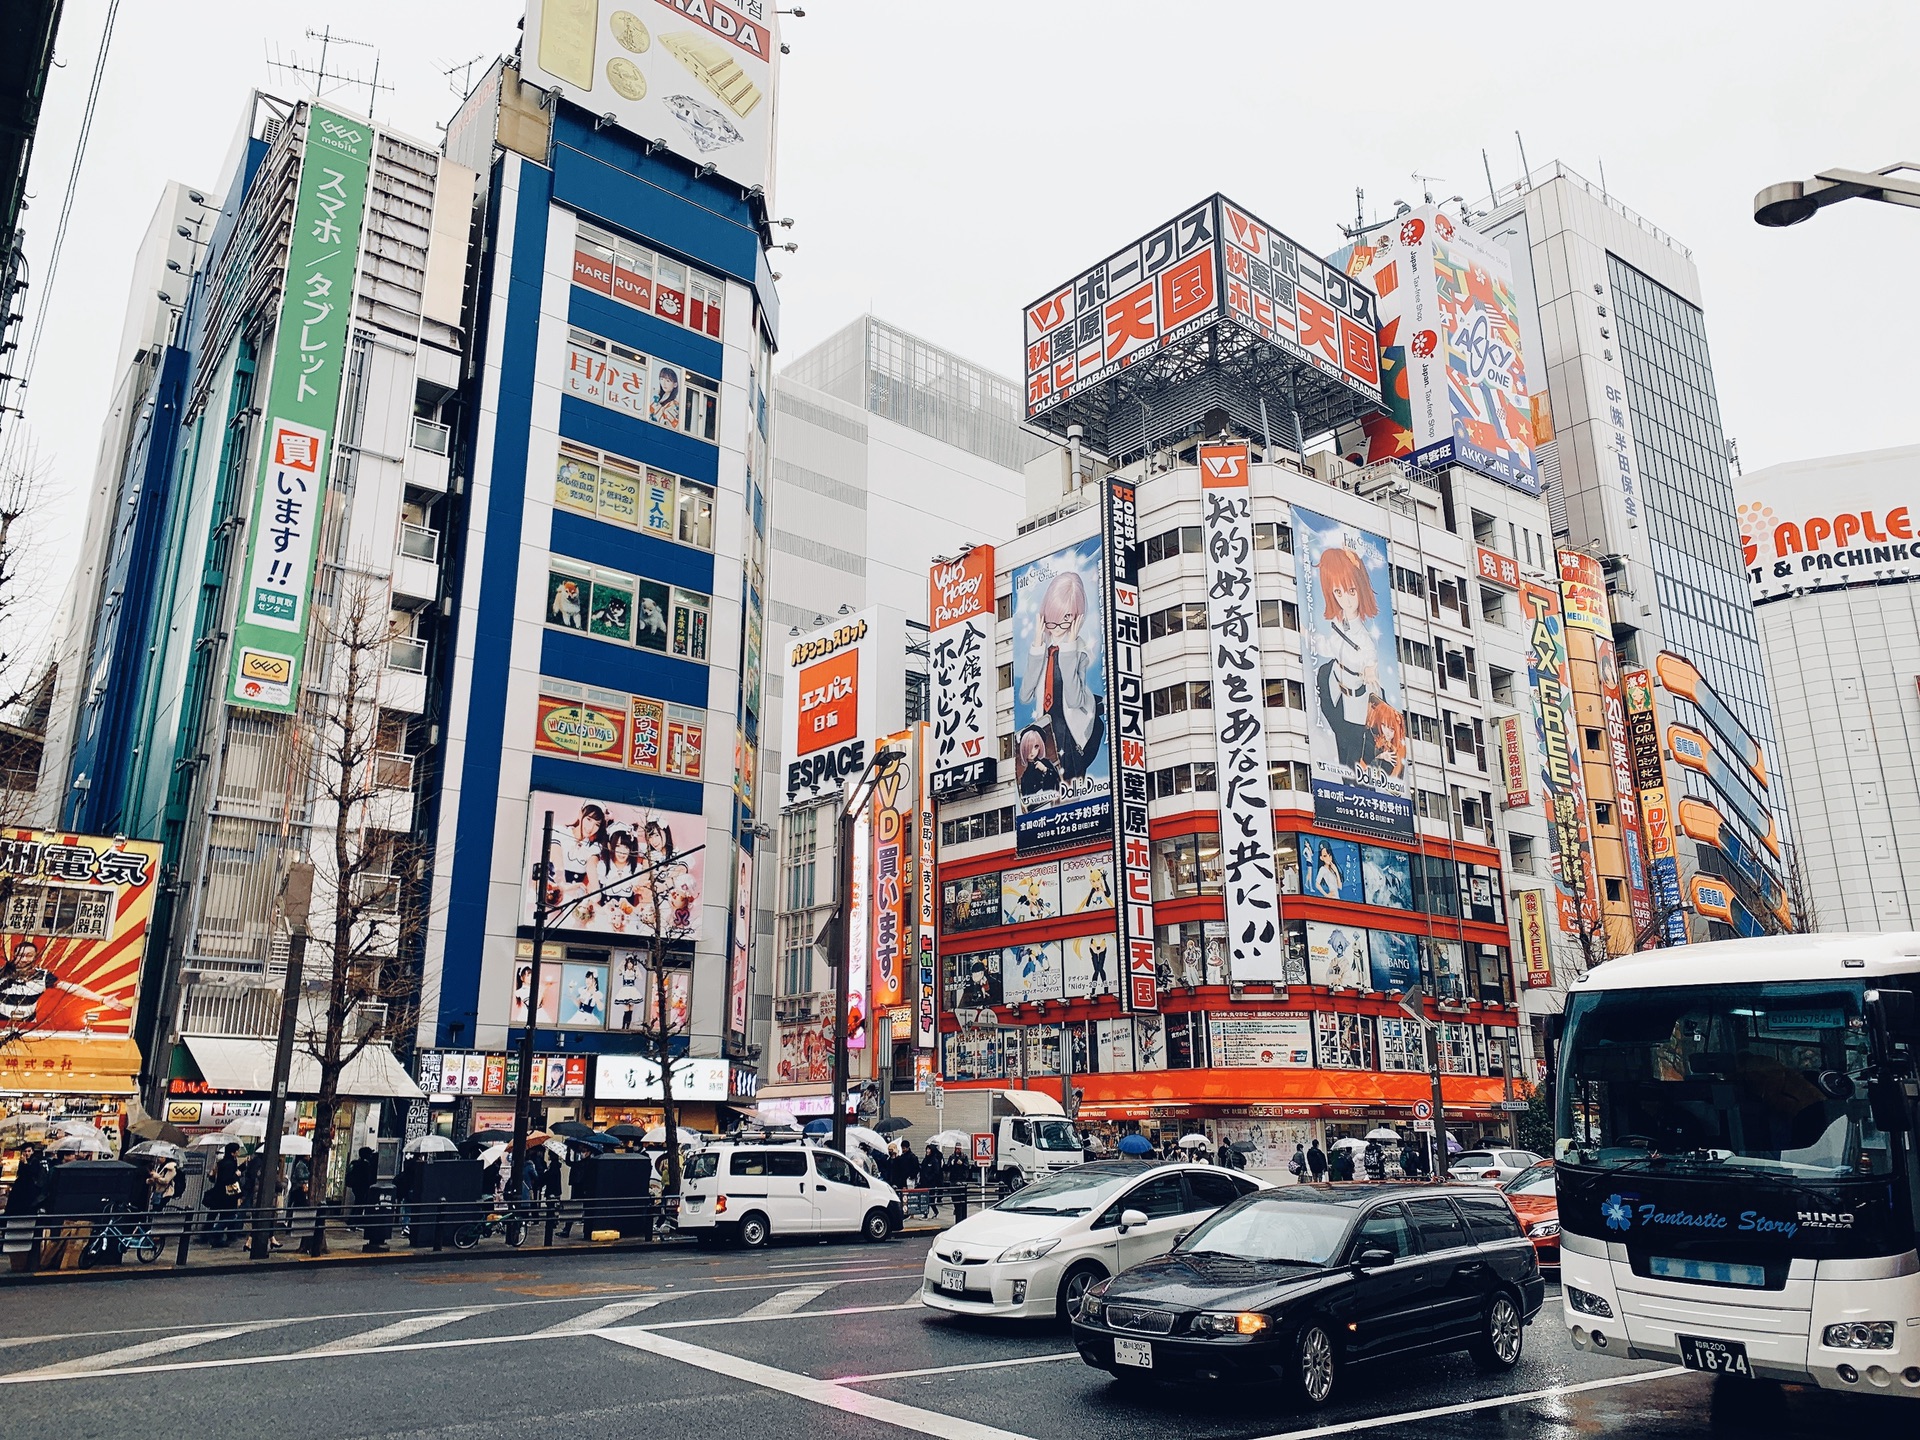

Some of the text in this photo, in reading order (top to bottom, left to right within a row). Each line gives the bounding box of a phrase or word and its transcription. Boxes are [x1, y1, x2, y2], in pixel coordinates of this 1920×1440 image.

[321, 135, 358, 155] mobile
[1077, 207, 1214, 315] ボークス
[1226, 243, 1293, 309] 秋葉原
[1272, 238, 1373, 326] ボークス
[1028, 308, 1101, 372] 秋葉原
[1028, 310, 1220, 416] VOLKS AKIHABARA HOBBY PARADISE
[1230, 308, 1383, 403] VOLKS AKIHABARA HOBBY PARADISE
[1486, 368, 1510, 389] ONE
[1605, 385, 1622, 403] 8F
[1123, 488, 1136, 552] HOBBY
[1112, 484, 1127, 580] PARADISE
[1481, 552, 1517, 586] 免税
[1117, 614, 1143, 738] ボークス
[1626, 674, 1648, 689] 激安
[801, 675, 853, 713] エスパス
[1527, 591, 1572, 787] TAX FREE
[1631, 713, 1653, 724] ゲーム
[1635, 723, 1652, 734] CD
[548, 718, 615, 741] WELCOME
[1634, 733, 1656, 746] アイドル
[1635, 744, 1658, 757] アニメ
[1674, 736, 1703, 758] SEGA
[788, 740, 865, 793] ESPACE
[1637, 755, 1659, 766] コミック
[1640, 767, 1660, 778] ホビー
[1511, 797, 1527, 806] ONE
[1646, 806, 1669, 854] DVD
[12, 896, 40, 914] 各種
[1698, 886, 1727, 909] SEGA
[80, 902, 106, 919] 配線
[9, 913, 37, 930] 電線
[76, 918, 103, 935] 器具
[1527, 913, 1544, 970] TAX FREE
[1387, 957, 1411, 970] BANG
[1319, 1013, 1336, 1030] 4F
[1382, 1021, 1402, 1036] 5F
[710, 1069, 723, 1079] 24
[708, 1082, 724, 1092] 時間
[1638, 1204, 1799, 1239] Fantastic Story
[1797, 1211, 1855, 1223] HINO
[1138, 1352, 1151, 1367] 25
[1695, 1348, 1747, 1375] 18-24
